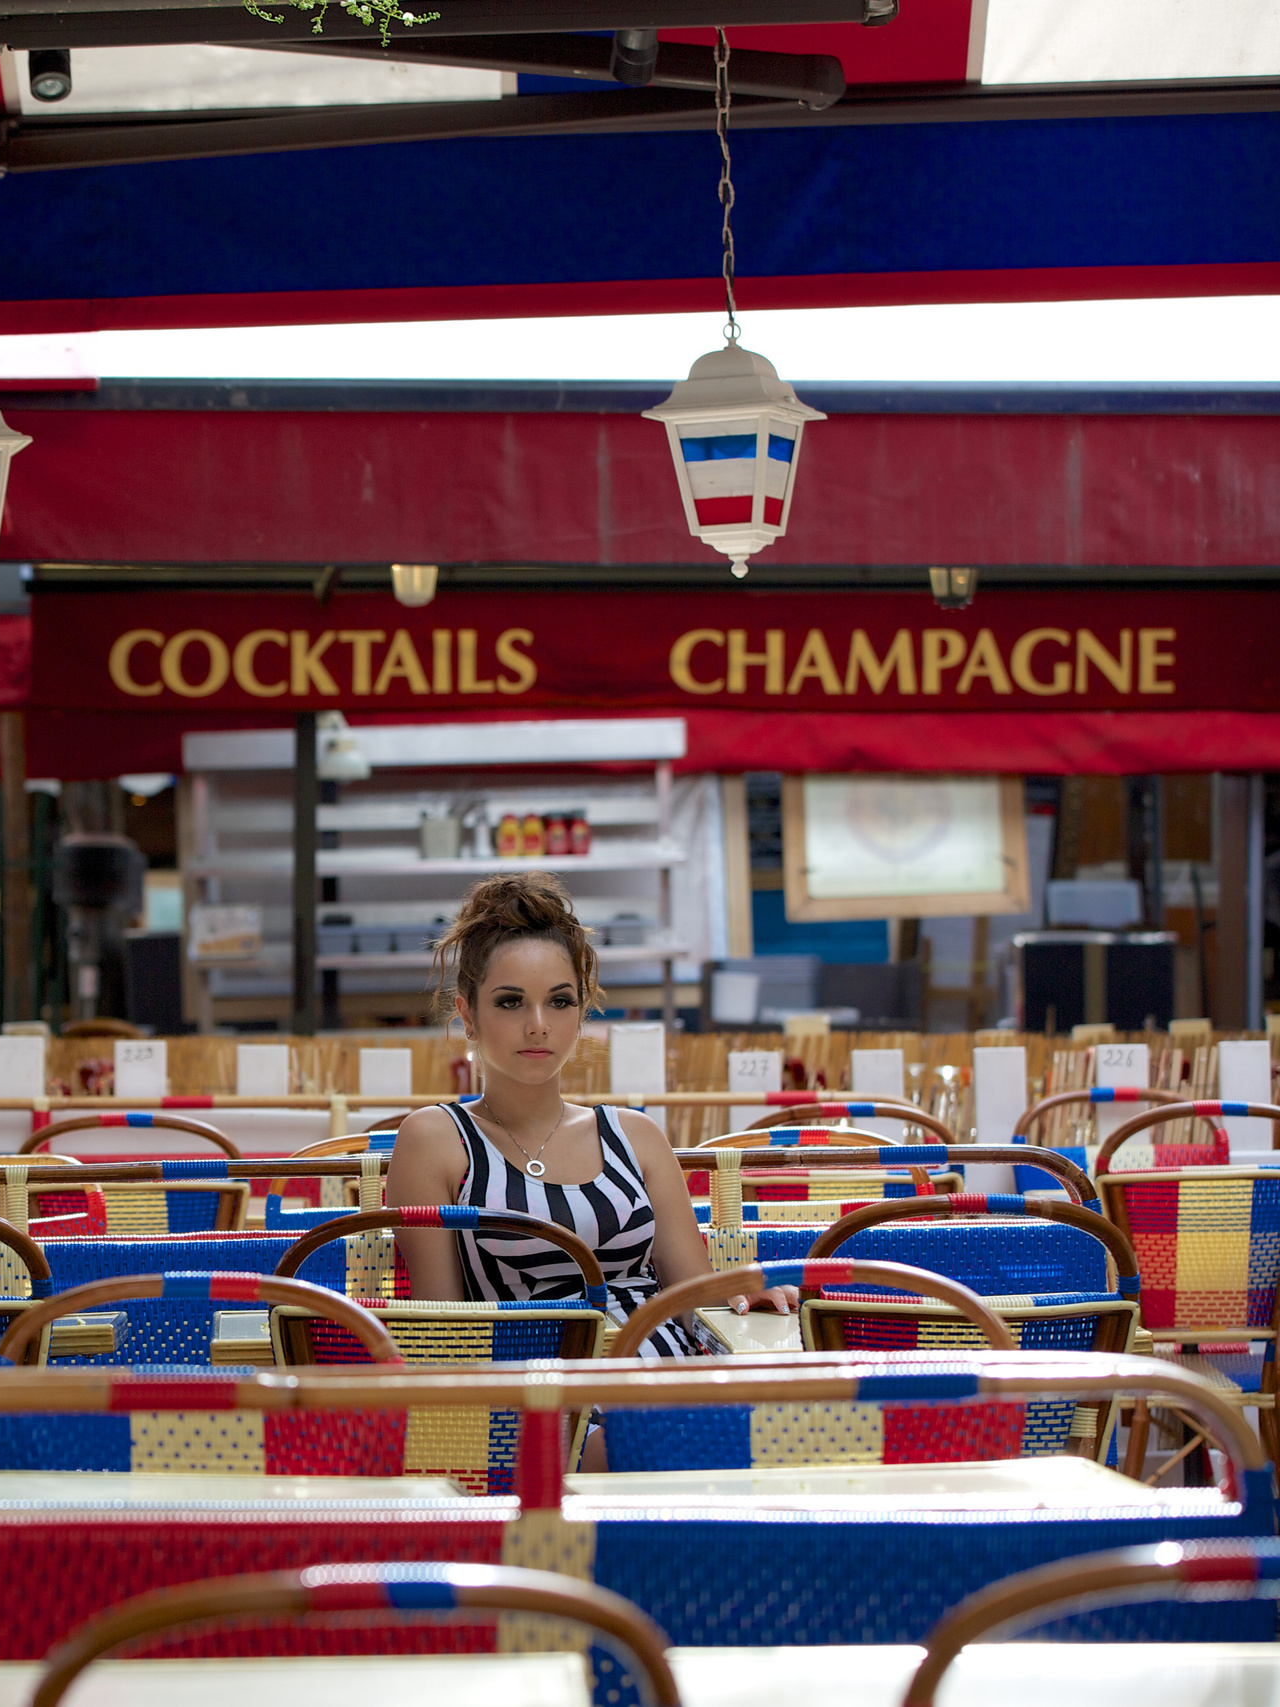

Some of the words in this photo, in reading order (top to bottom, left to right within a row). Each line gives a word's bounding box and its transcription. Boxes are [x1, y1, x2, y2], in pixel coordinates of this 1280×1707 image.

[108, 628, 538, 698] COCKTAILS
[668, 627, 1177, 696] CHAMPAGNE
[737, 1059, 769, 1077] 227
[1102, 1049, 1135, 1068] 226
